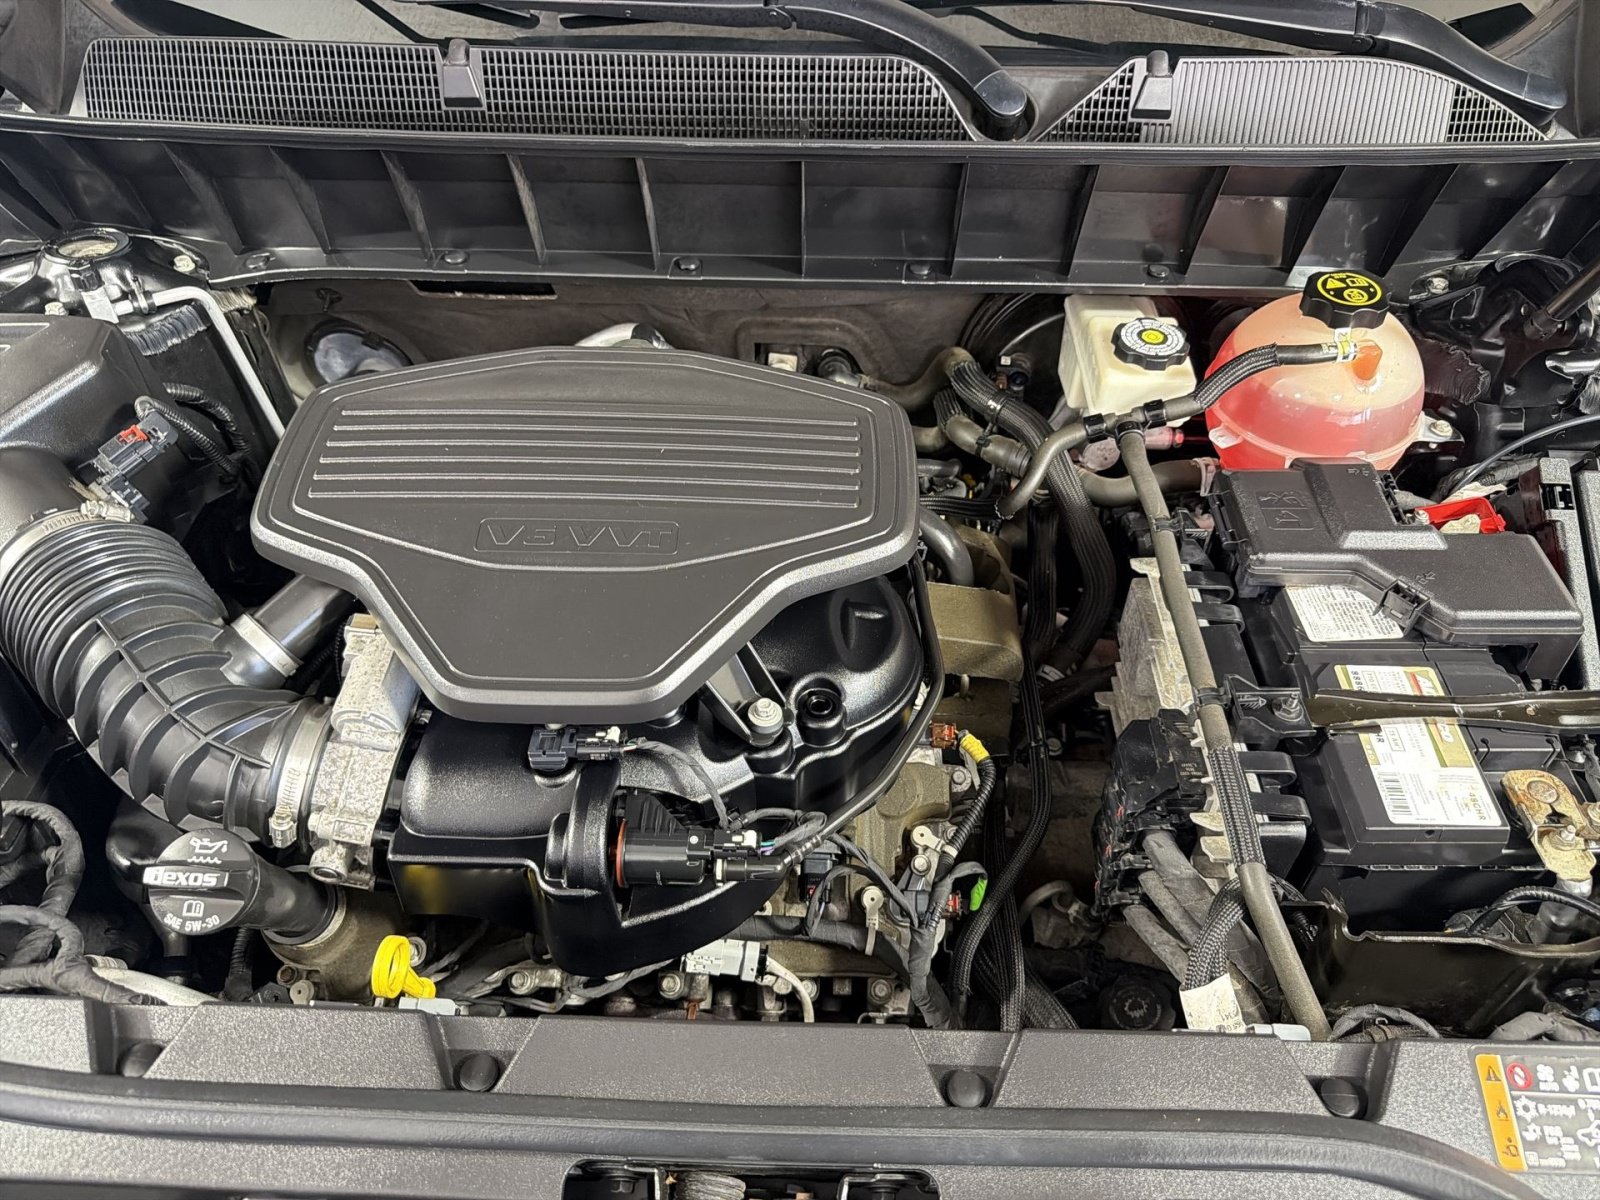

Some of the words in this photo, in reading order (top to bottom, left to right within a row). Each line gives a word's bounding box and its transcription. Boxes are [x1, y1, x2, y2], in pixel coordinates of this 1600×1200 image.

[569, 526, 672, 548] VVT
[150, 867, 221, 886] dexos
[164, 913, 183, 930] SAE
[184, 914, 220, 932] 5W-30
